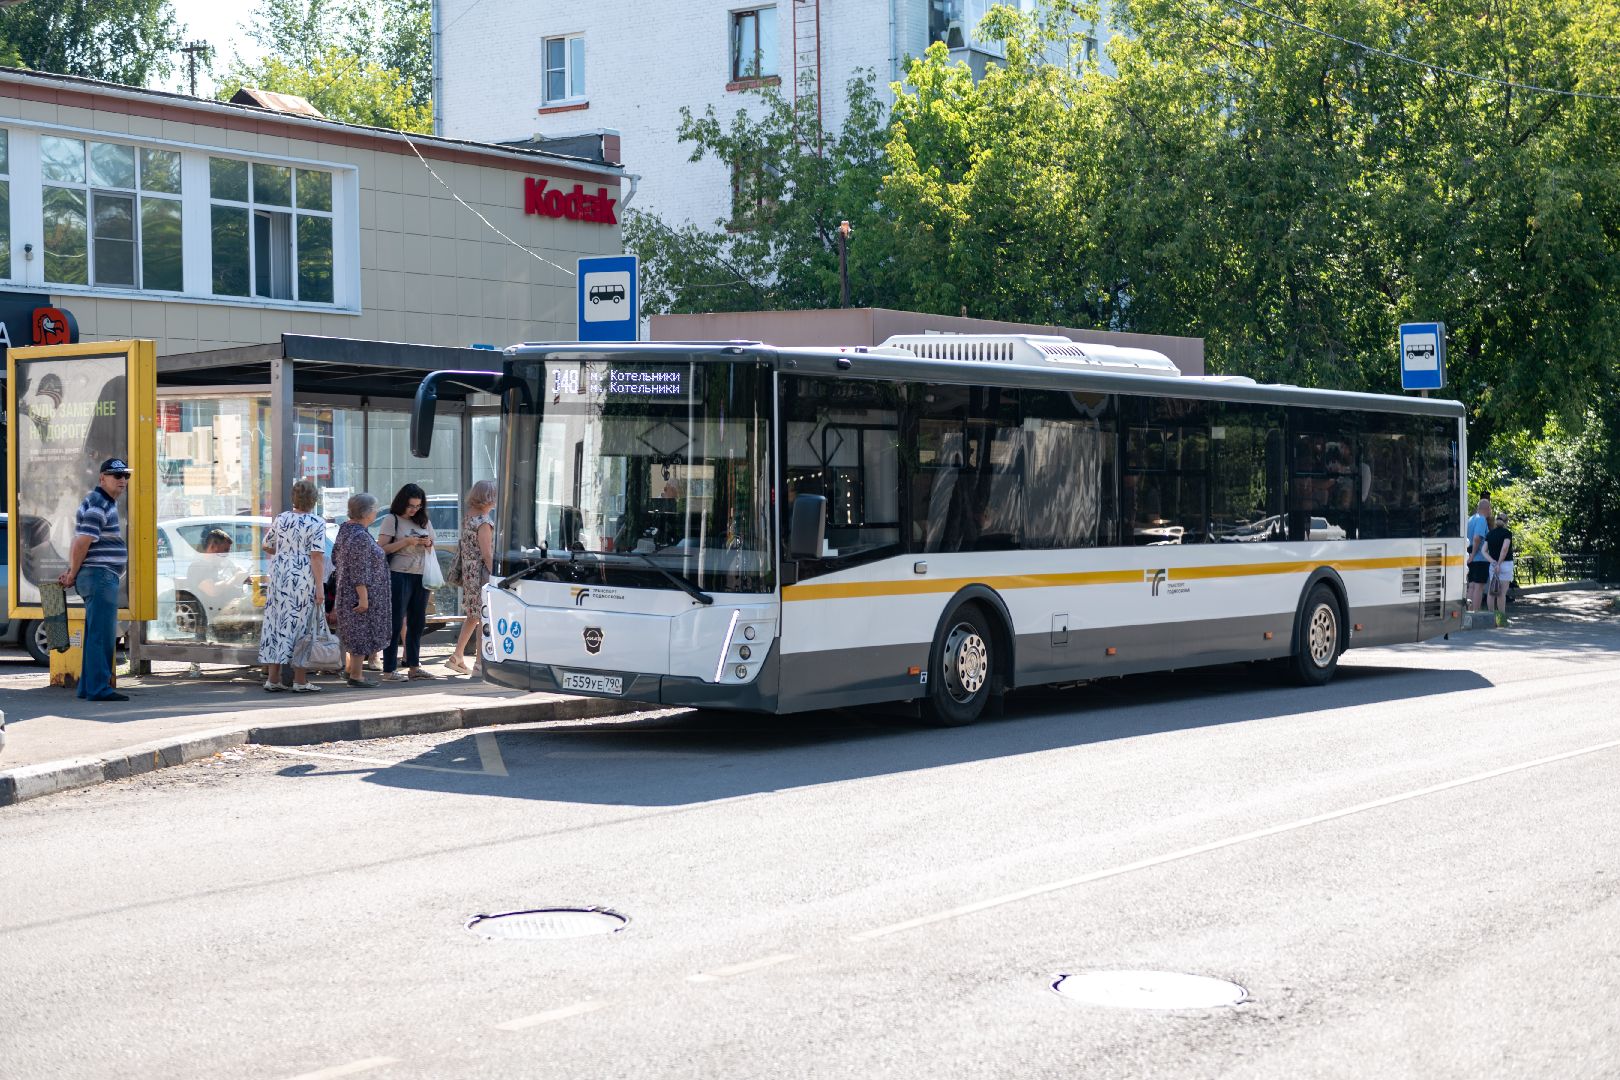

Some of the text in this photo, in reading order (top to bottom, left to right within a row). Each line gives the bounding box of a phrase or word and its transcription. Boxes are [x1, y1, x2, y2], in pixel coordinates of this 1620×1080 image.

[524, 177, 617, 225] Kodak
[552, 369, 579, 394] 348
[610, 369, 681, 382] Котельники
[610, 381, 680, 394] Котельники
[60, 400, 116, 418] ЗАМЕТНЕЕ
[46, 423, 86, 441] ДОРОГЕ
